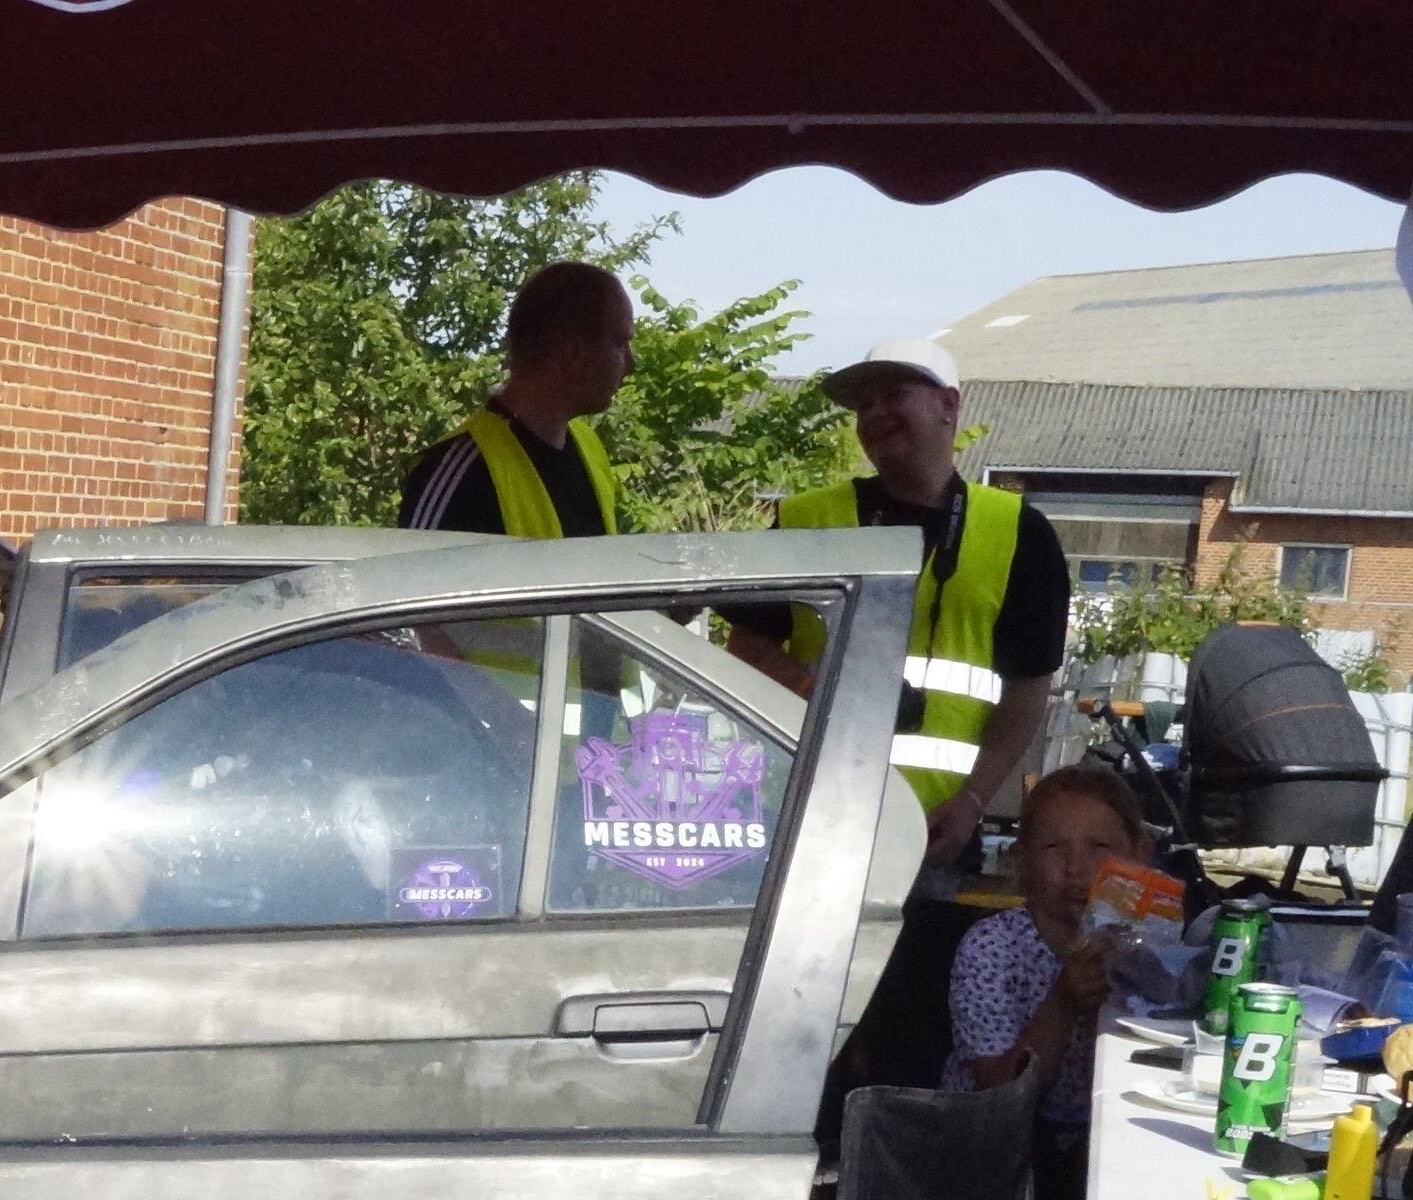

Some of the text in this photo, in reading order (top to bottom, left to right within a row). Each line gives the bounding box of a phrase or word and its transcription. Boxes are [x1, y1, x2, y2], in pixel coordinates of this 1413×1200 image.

[584, 822, 766, 848] MESSCARS
[646, 857, 705, 867] EST 2024
[407, 888, 483, 901] MESSCARS
[1212, 938, 1246, 976] B
[1233, 1033, 1285, 1081] B
